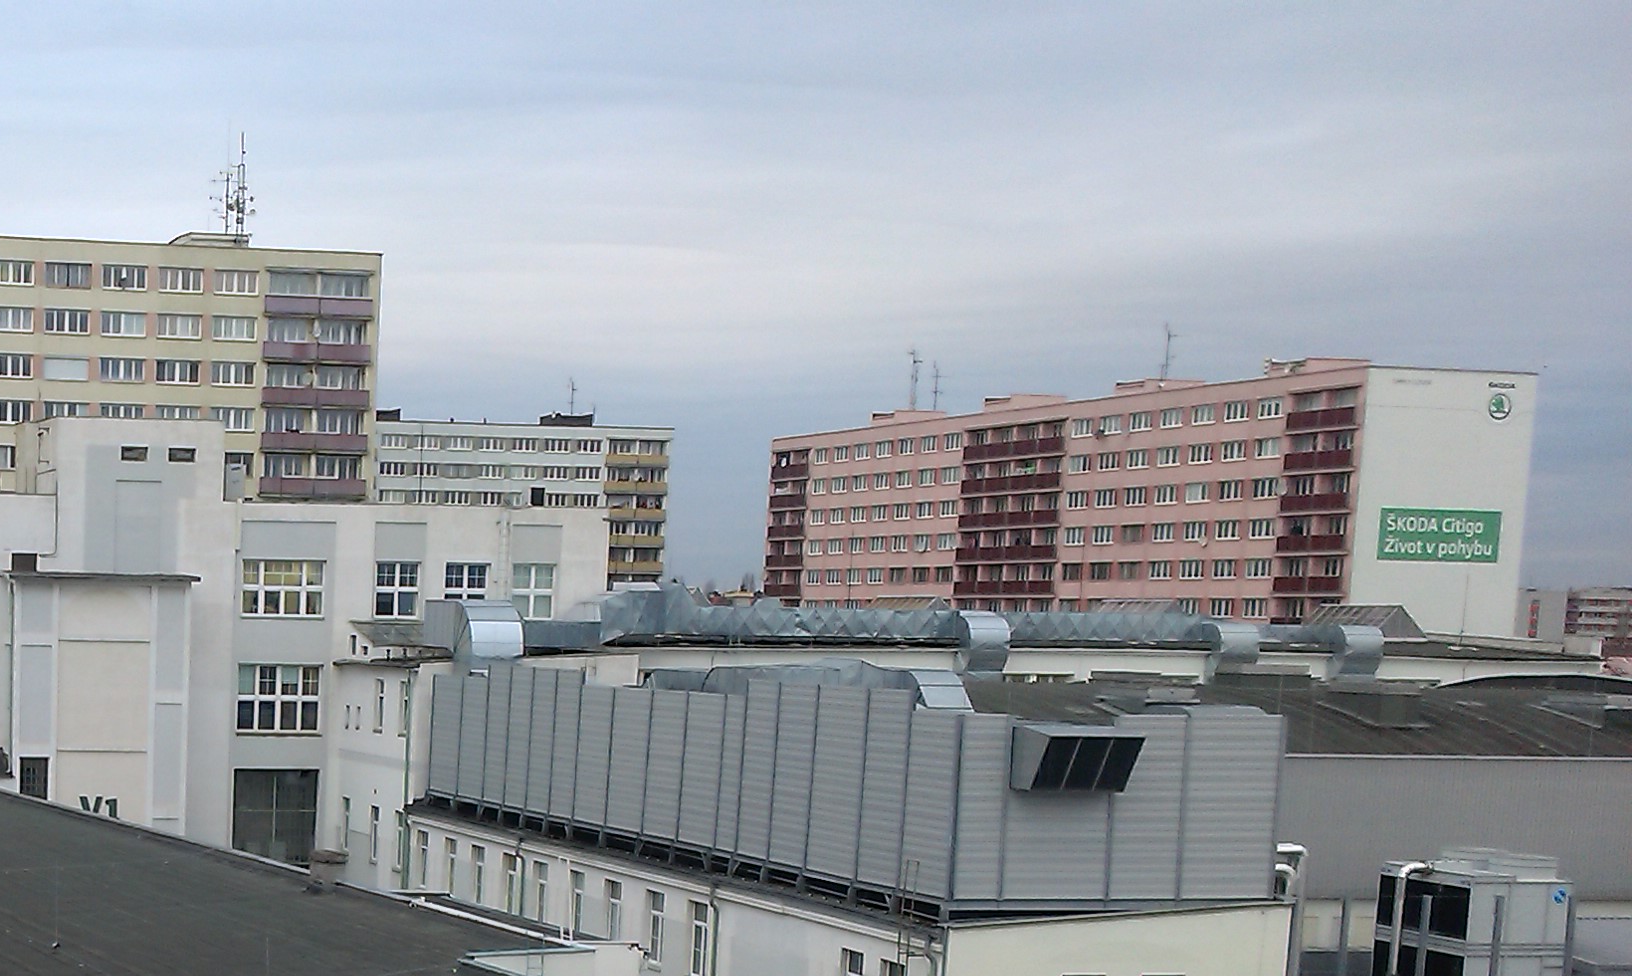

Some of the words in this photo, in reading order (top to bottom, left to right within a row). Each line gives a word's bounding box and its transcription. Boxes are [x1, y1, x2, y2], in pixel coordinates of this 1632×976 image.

[1386, 512, 1438, 532] ŠKODA
[1442, 517, 1484, 537] Citigo
[1383, 535, 1423, 553] Život
[1426, 542, 1436, 553] v
[1438, 539, 1492, 558] pohybu
